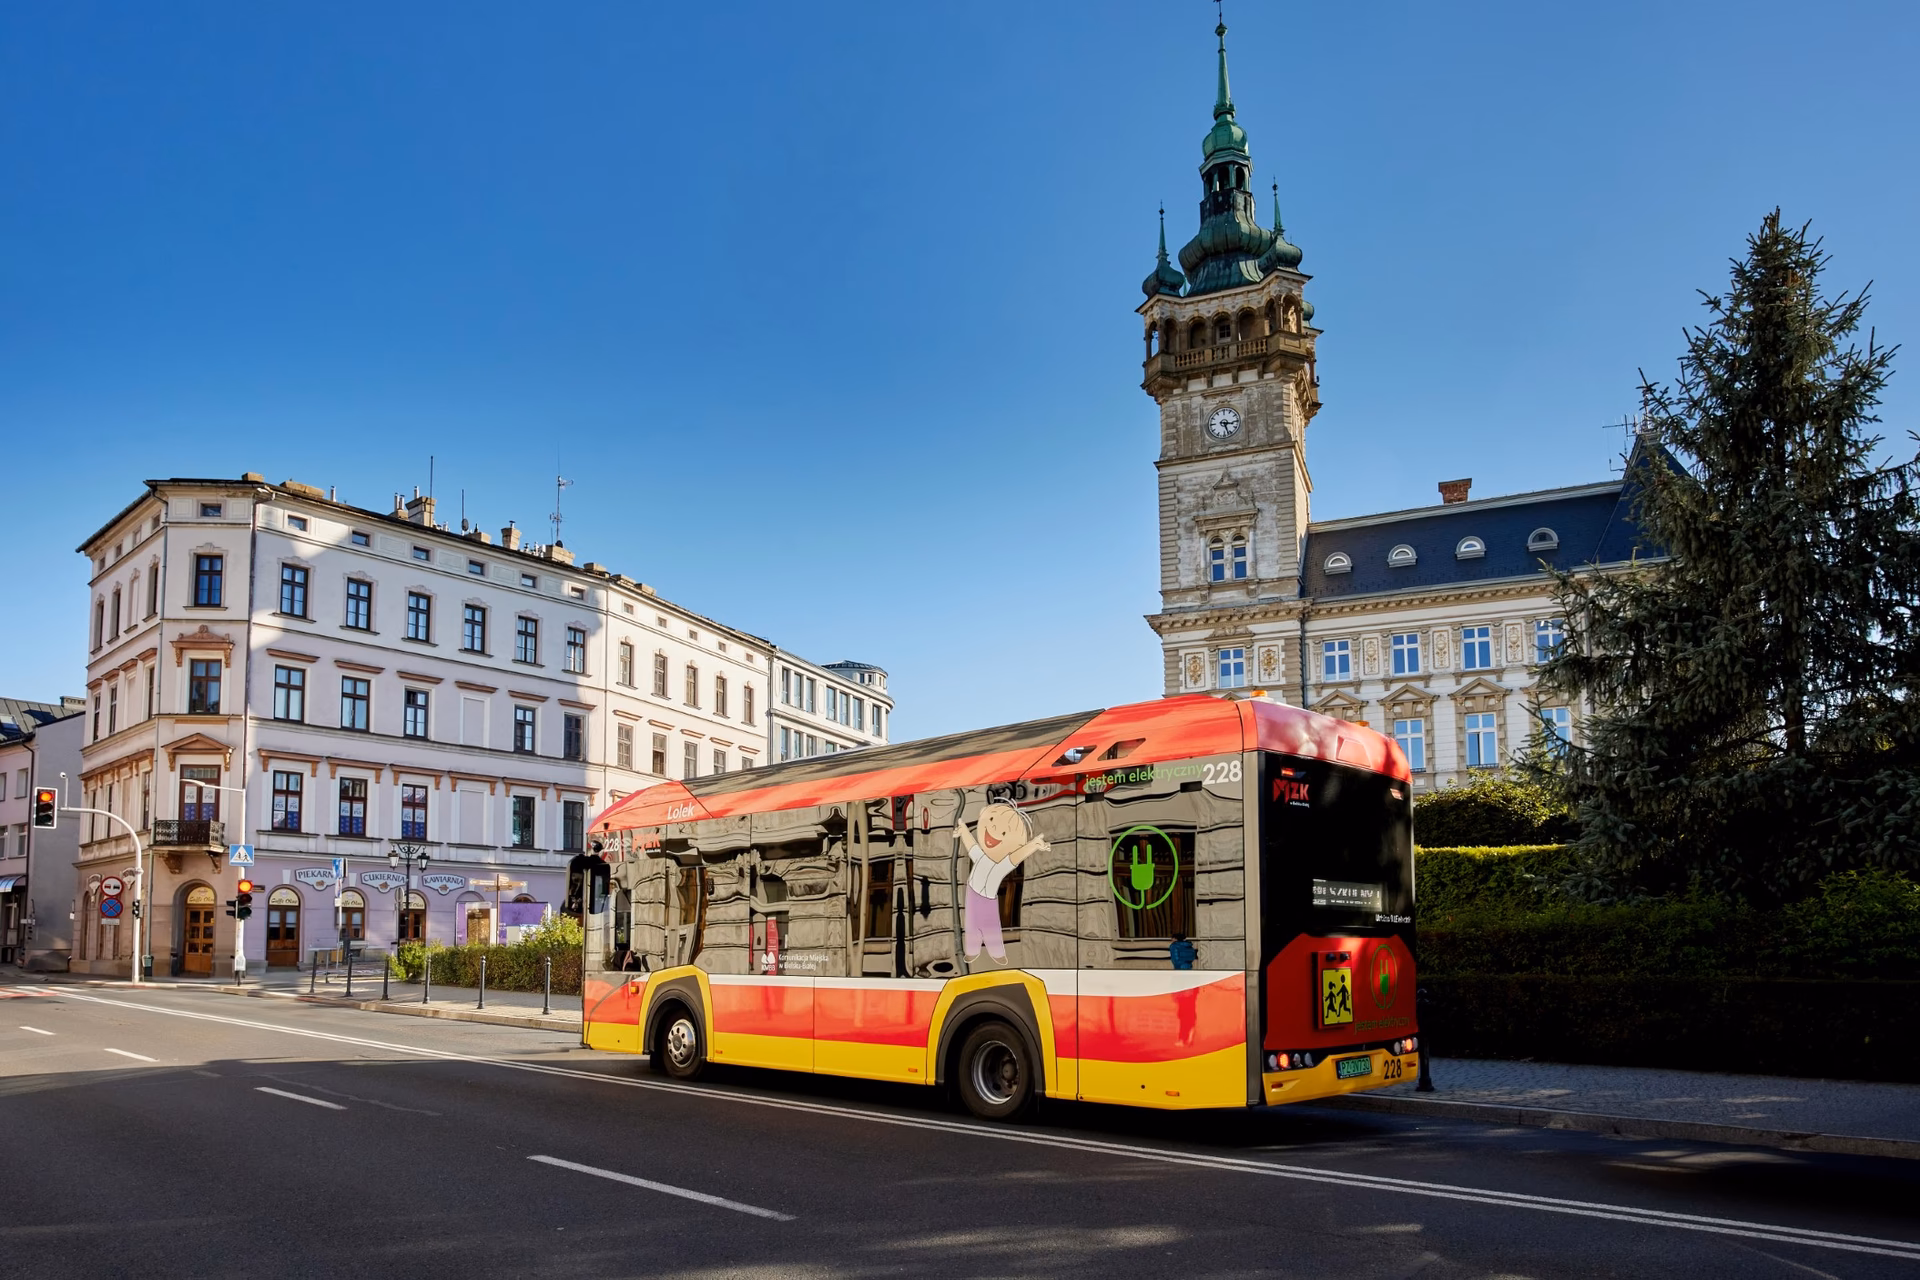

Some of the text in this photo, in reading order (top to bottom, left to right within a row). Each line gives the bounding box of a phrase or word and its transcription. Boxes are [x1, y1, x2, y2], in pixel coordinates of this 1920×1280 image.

[1084, 763, 1204, 791] jestem elektryczny
[1203, 760, 1243, 784] 228
[1273, 778, 1310, 803] MZK
[667, 802, 695, 820] Lolek
[604, 838, 620, 852] 228
[297, 868, 334, 880] PIEKARN
[363, 873, 406, 884] CUKIERNIA
[423, 876, 465, 887] KAWIARNIA
[778, 954, 829, 964] Komunikacja Miejska
[1354, 1018, 1377, 1036] jestem
[1384, 1058, 1402, 1080] 228
